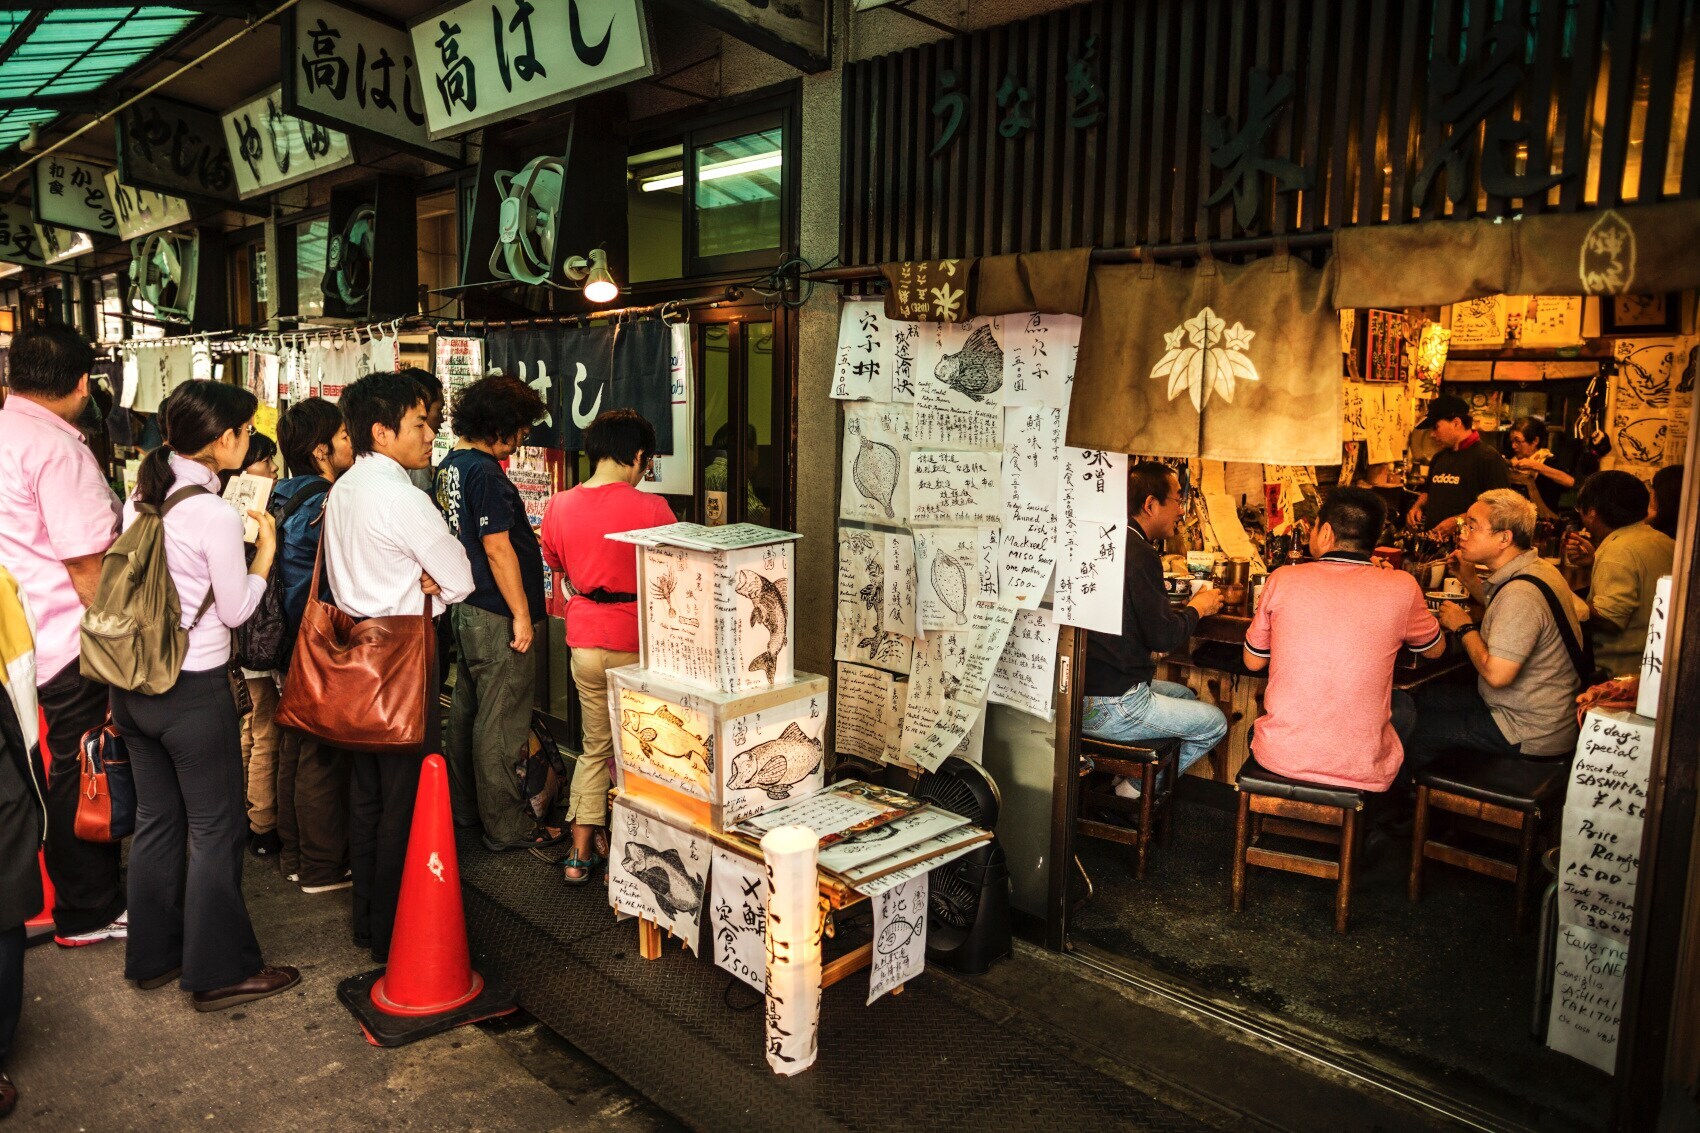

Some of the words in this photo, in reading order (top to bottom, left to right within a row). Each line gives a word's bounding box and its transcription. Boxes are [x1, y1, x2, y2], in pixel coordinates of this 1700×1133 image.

[435, 0, 616, 117] 高はし
[931, 34, 1106, 159] うなぎ
[1203, 30, 1578, 230] 米花
[49, 162, 65, 197] 和食
[853, 311, 881, 383] 穴子丼
[486, 359, 604, 430] はし
[1579, 819, 1619, 843] Price
[1561, 984, 1617, 1011] SASHIMI
